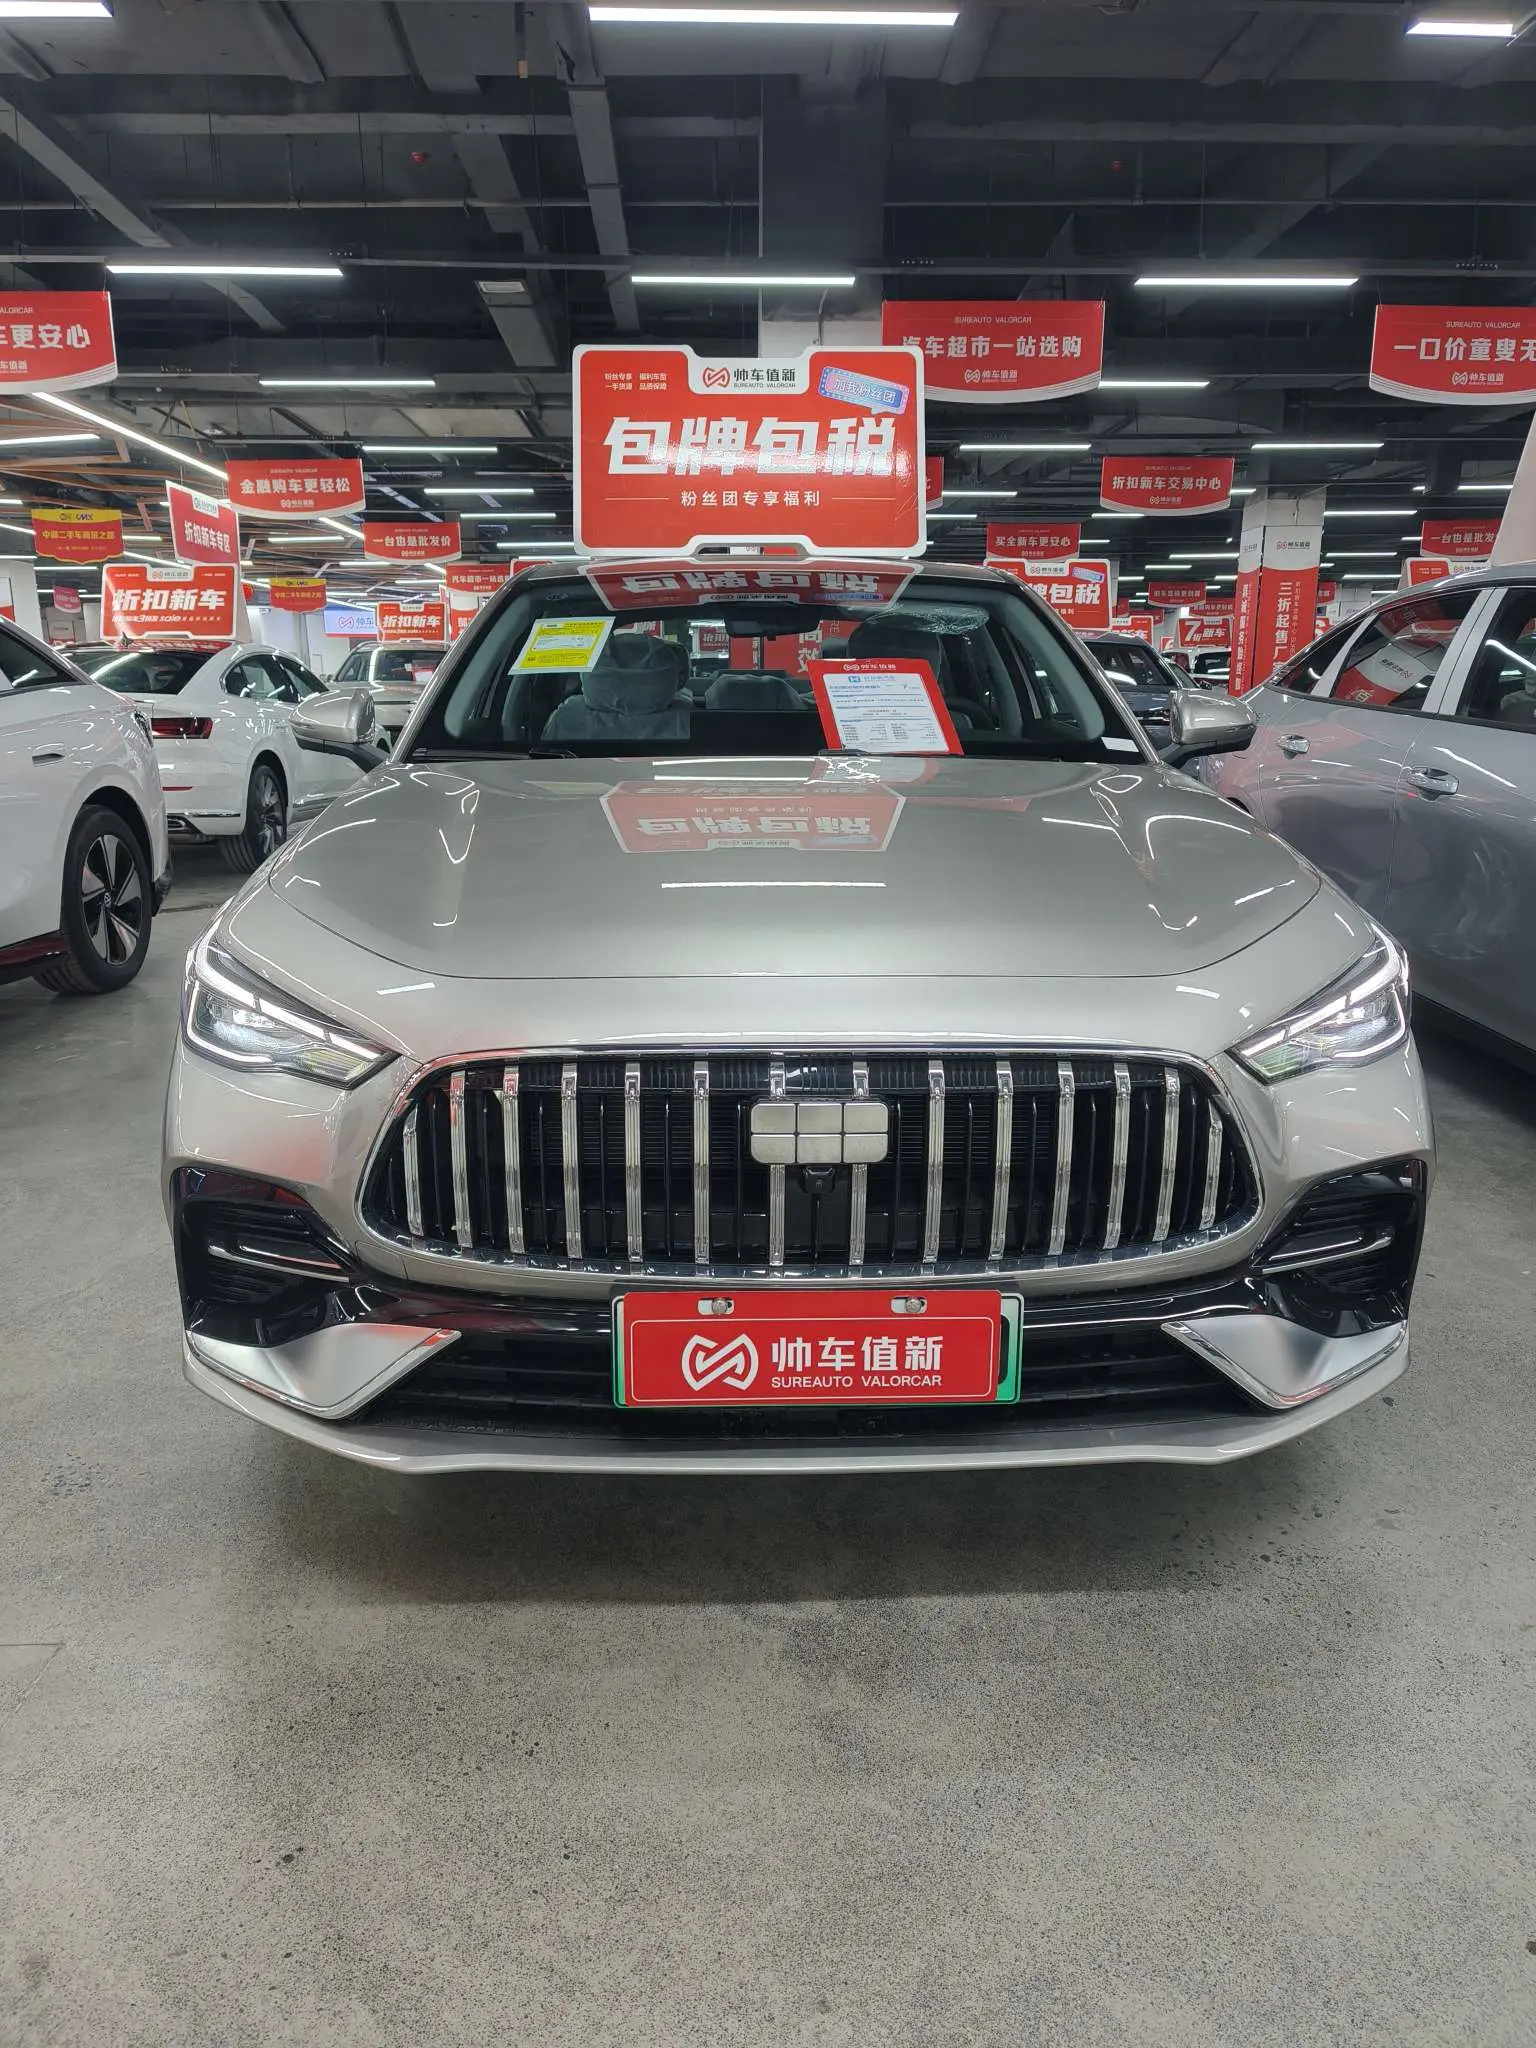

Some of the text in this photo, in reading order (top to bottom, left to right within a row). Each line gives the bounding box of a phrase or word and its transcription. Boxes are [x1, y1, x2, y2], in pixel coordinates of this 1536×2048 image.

[1446, 321, 1521, 329] SUREAUTO VALORCAR
[0, 360, 28, 370] 车值新
[734, 368, 796, 381] 帅车值新
[603, 416, 896, 477] 包牌包税
[240, 478, 350, 494] 金融购车更轻松
[1112, 476, 1221, 490] 折扣新车交易中心
[681, 490, 820, 506] 粉丝团专享福利
[373, 535, 451, 547] 一台也是批发价
[452, 575, 508, 583] 汽车超市一站选
[112, 589, 226, 611] 折扣新车
[383, 615, 440, 628] 折扣新车
[771, 1335, 944, 1372] 帅车值新
[771, 1375, 942, 1388] SUREAUTO VALORCAR
